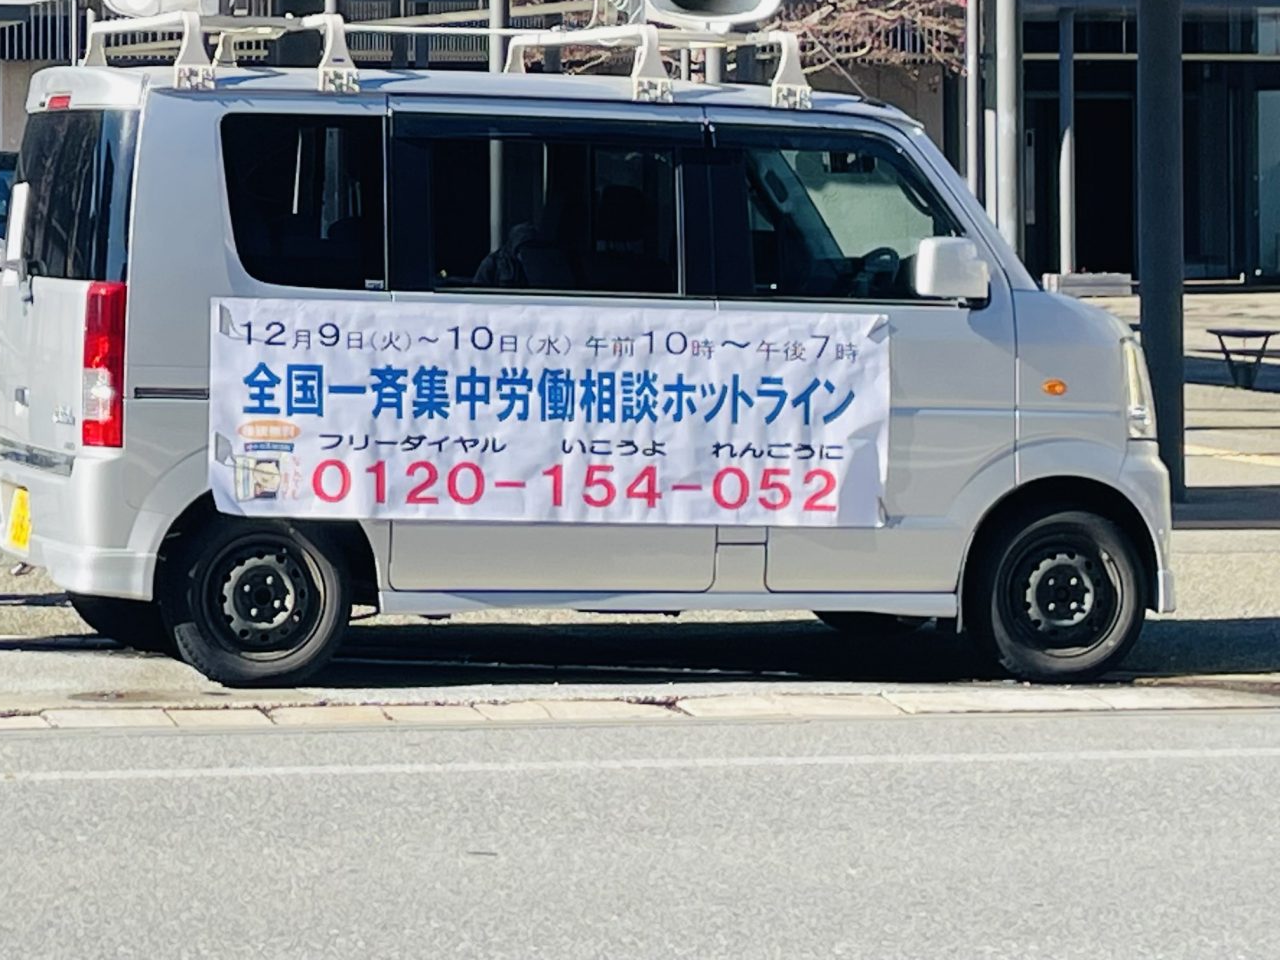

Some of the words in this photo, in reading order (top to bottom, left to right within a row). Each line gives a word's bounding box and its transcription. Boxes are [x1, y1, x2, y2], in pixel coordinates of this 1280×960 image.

[242, 362, 855, 425] 全国一斉集中労働相談ホットライン
[319, 434, 507, 453] フリーダイヤル
[562, 439, 666, 456] いこうよ
